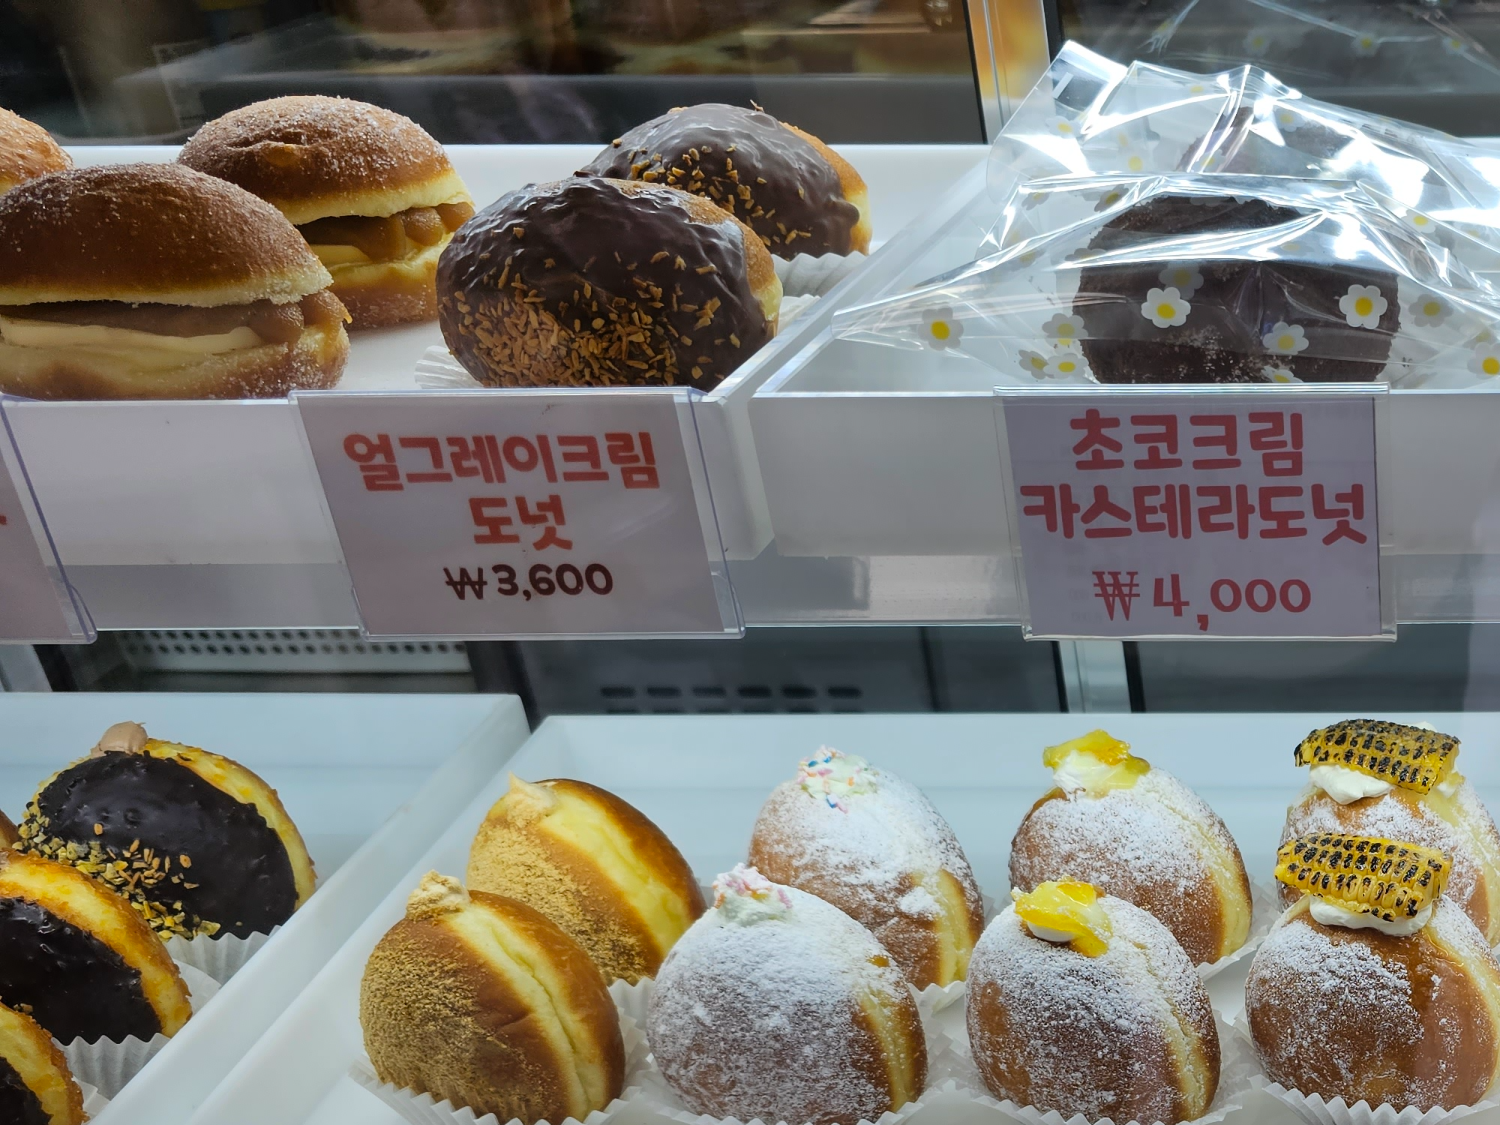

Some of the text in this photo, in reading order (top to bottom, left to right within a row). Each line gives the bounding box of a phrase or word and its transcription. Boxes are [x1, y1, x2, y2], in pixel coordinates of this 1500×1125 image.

[343, 431, 660, 491] 얼그레이크림
[1070, 408, 1304, 477] 초코크림
[468, 494, 573, 551] 도넛
[1020, 483, 1368, 546] 카스테라도넛
